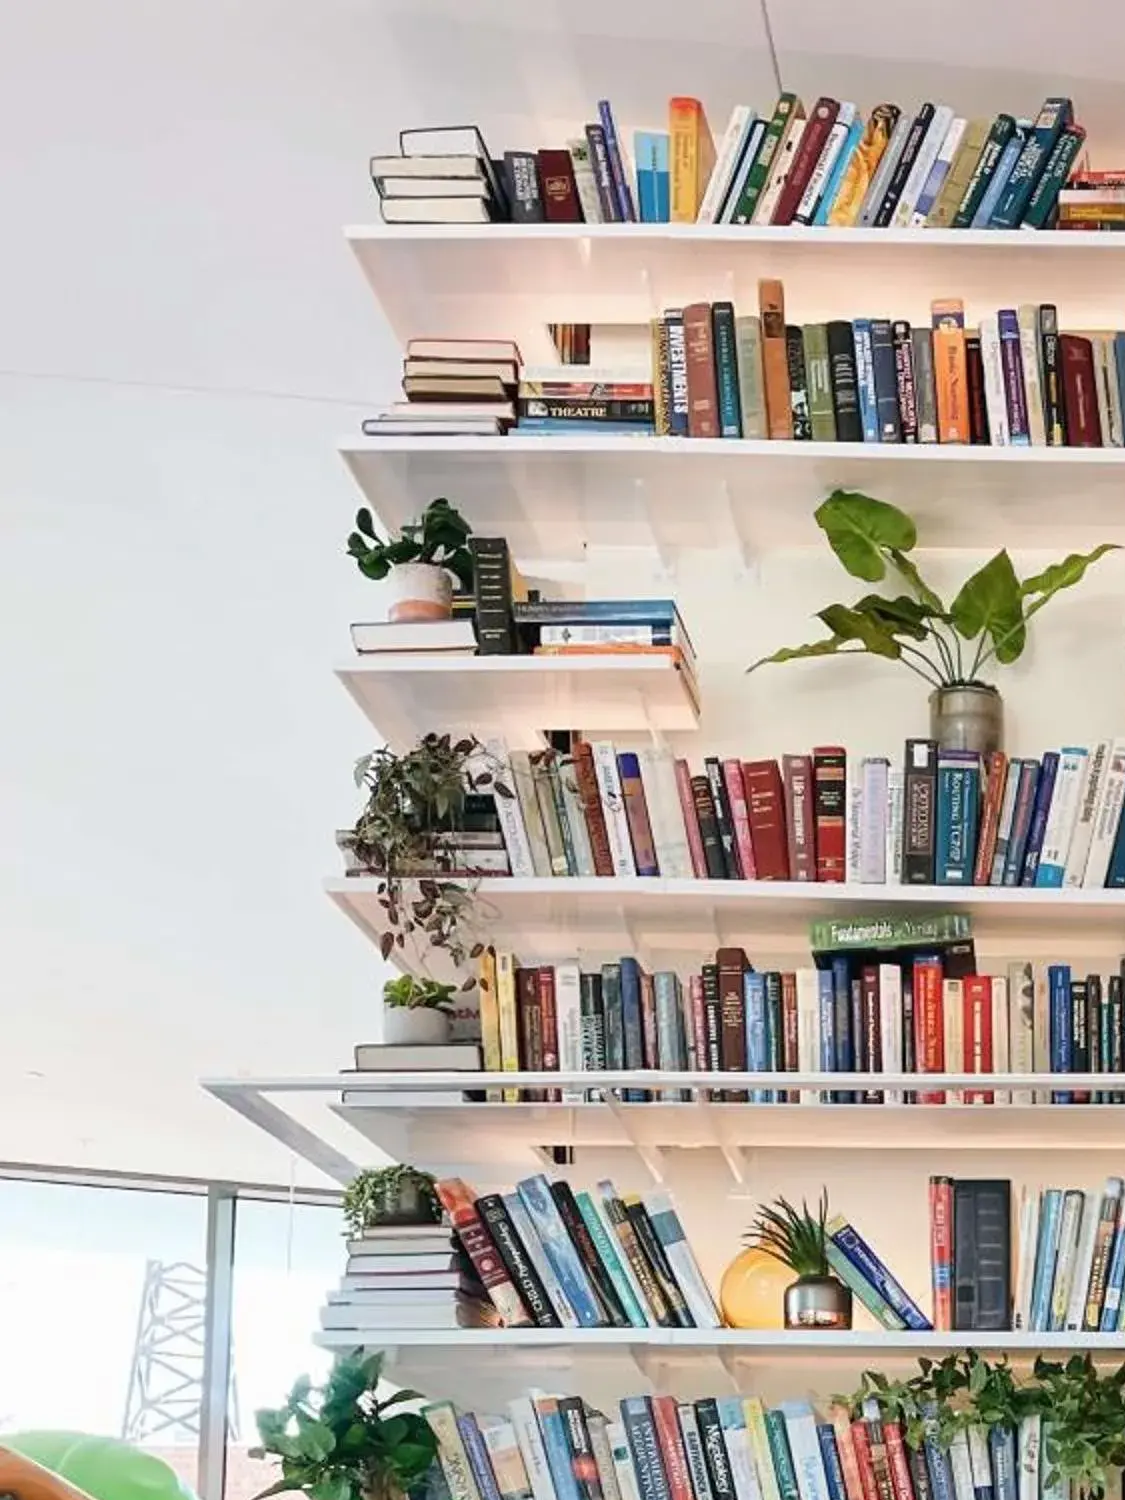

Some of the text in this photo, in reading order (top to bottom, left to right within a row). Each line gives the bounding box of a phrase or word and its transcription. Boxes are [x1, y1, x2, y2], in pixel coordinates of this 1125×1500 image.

[670, 325, 687, 413] INVESTMENTS
[550, 405, 607, 417] THEATRE
[794, 775, 806, 845] Life Insurance
[951, 772, 963, 821] ROUTING
[705, 1424, 729, 1493] Microbiology
